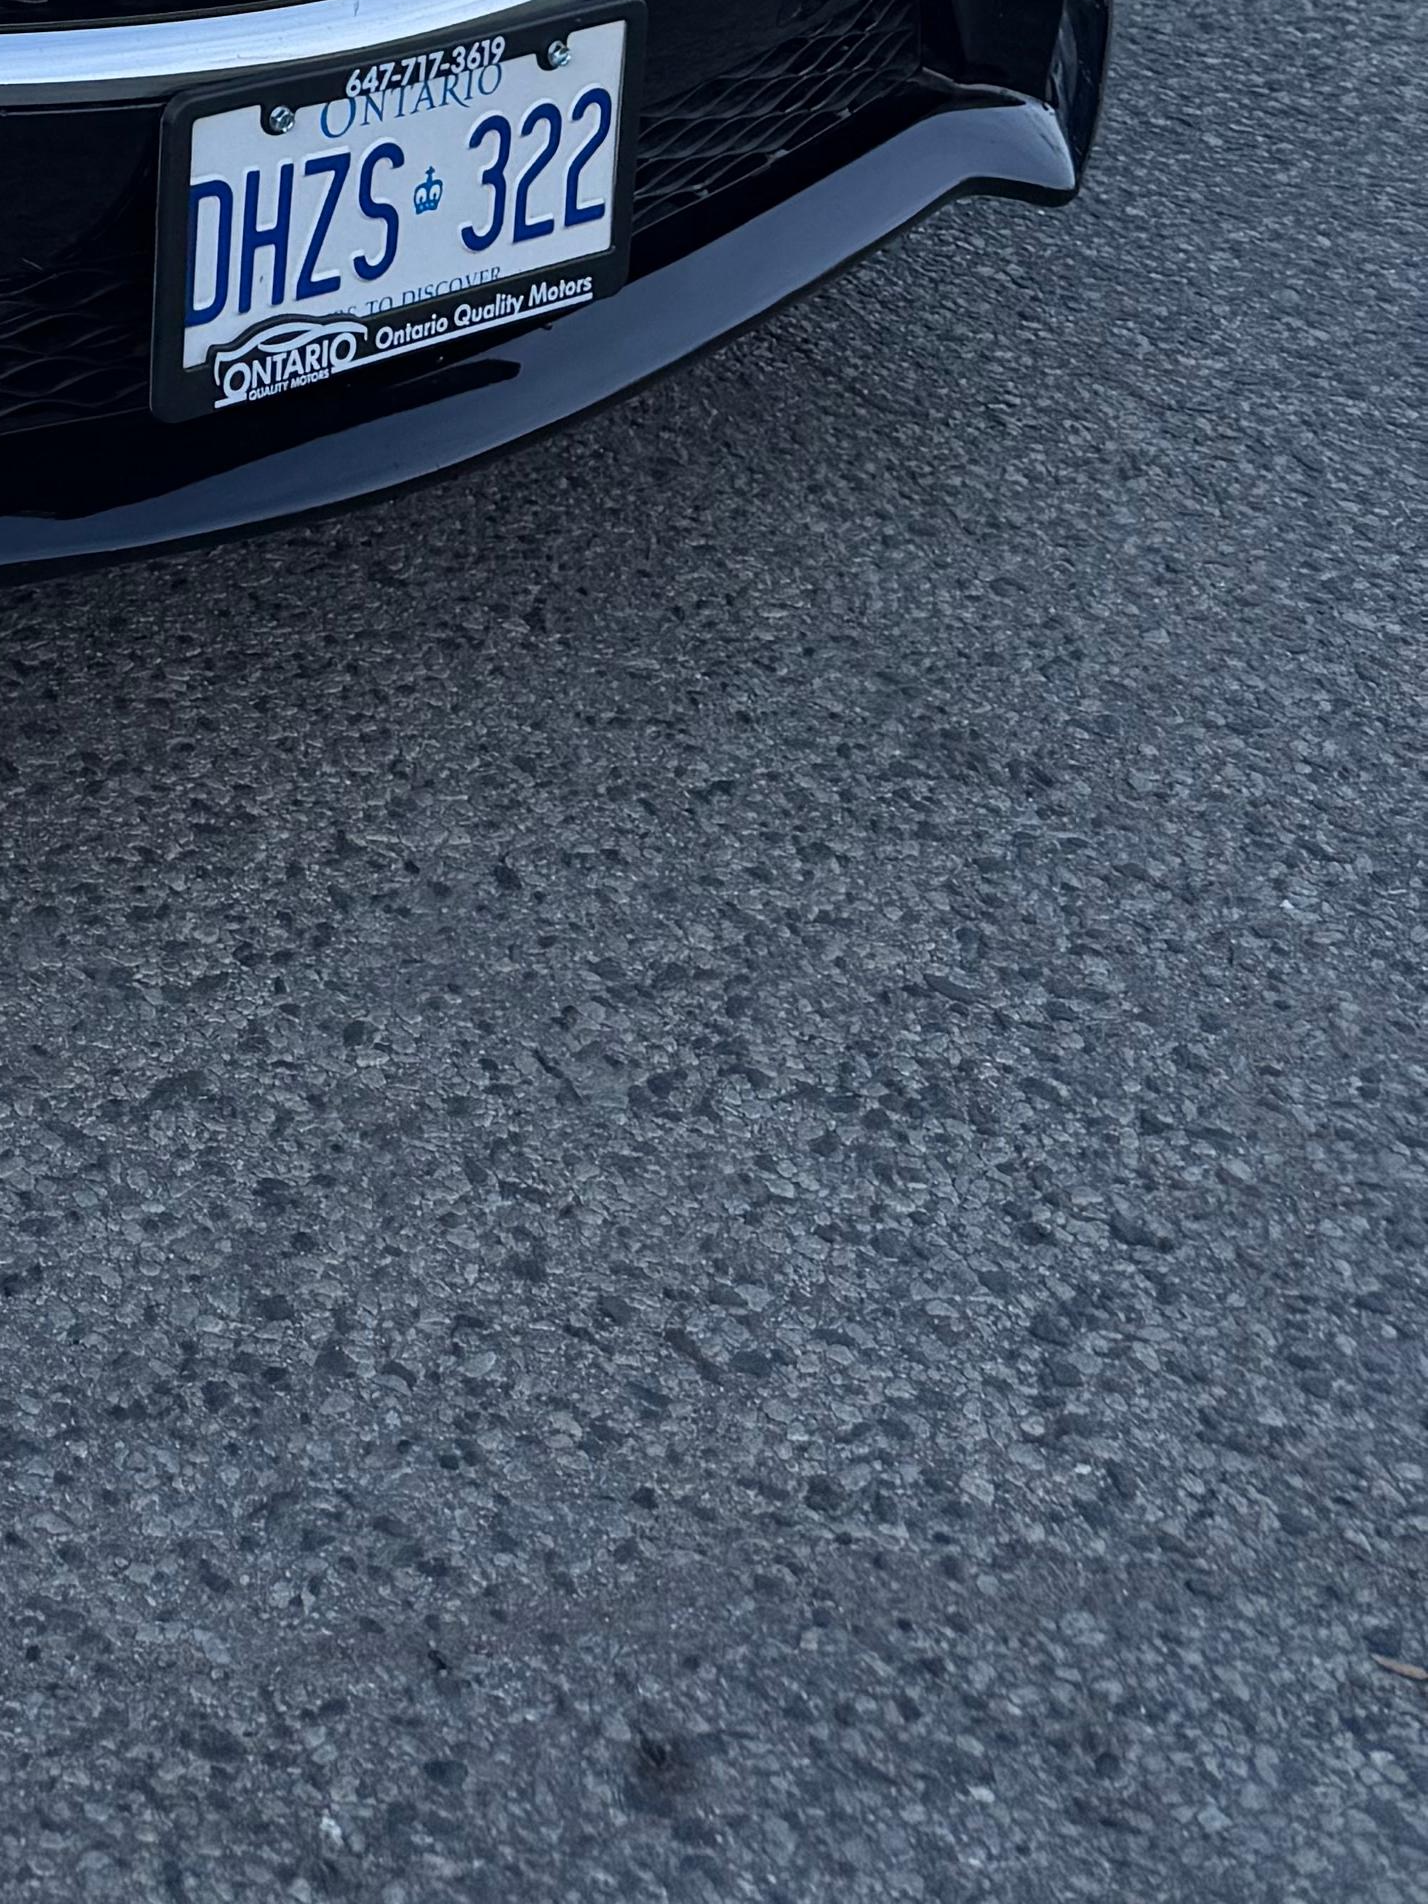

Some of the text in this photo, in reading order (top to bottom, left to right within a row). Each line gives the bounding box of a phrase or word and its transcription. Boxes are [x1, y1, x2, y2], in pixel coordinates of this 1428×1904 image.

[320, 63, 503, 139] ONTARIO
[345, 35, 507, 98] 647-717-3619
[184, 87, 612, 327] DHZS 322
[374, 274, 593, 350] Ontario Quality Motors
[223, 331, 358, 398] ONTARIO
[248, 367, 330, 402] QUALITY MOTORS
